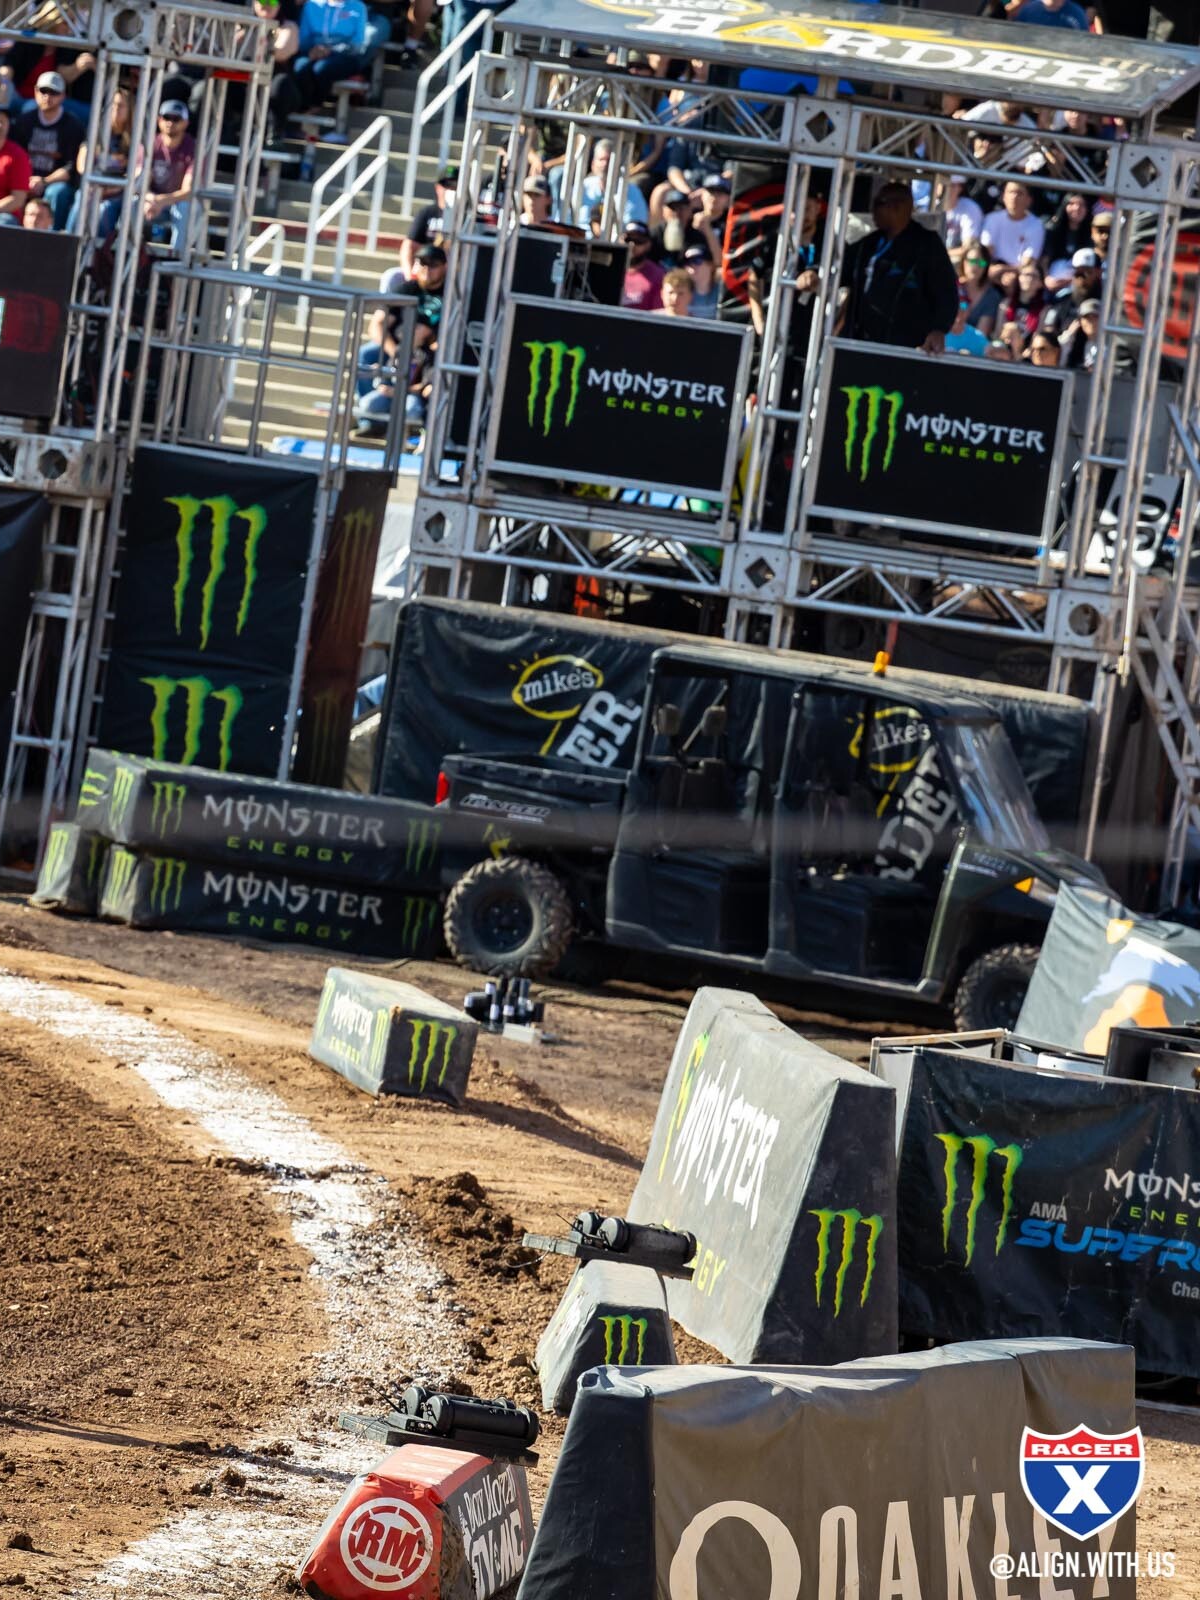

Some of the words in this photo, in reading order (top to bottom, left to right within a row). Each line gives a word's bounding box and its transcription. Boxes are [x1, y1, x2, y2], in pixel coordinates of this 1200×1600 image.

[587, 367, 727, 408] MONSTER
[606, 397, 704, 420] ENERGY
[904, 412, 1046, 453] MONSTER
[923, 441, 1024, 465] ENERGY
[522, 668, 596, 703] mike's
[202, 794, 386, 848] MONSTER
[226, 835, 355, 864] ENERGY
[203, 870, 383, 925] MONSTER
[227, 911, 354, 941] ENERGY
[672, 1059, 780, 1231] MONSTER
[1029, 1201, 1068, 1222] AMA
[1014, 1218, 1200, 1273] SUPER
[355, 1518, 425, 1569] RM
